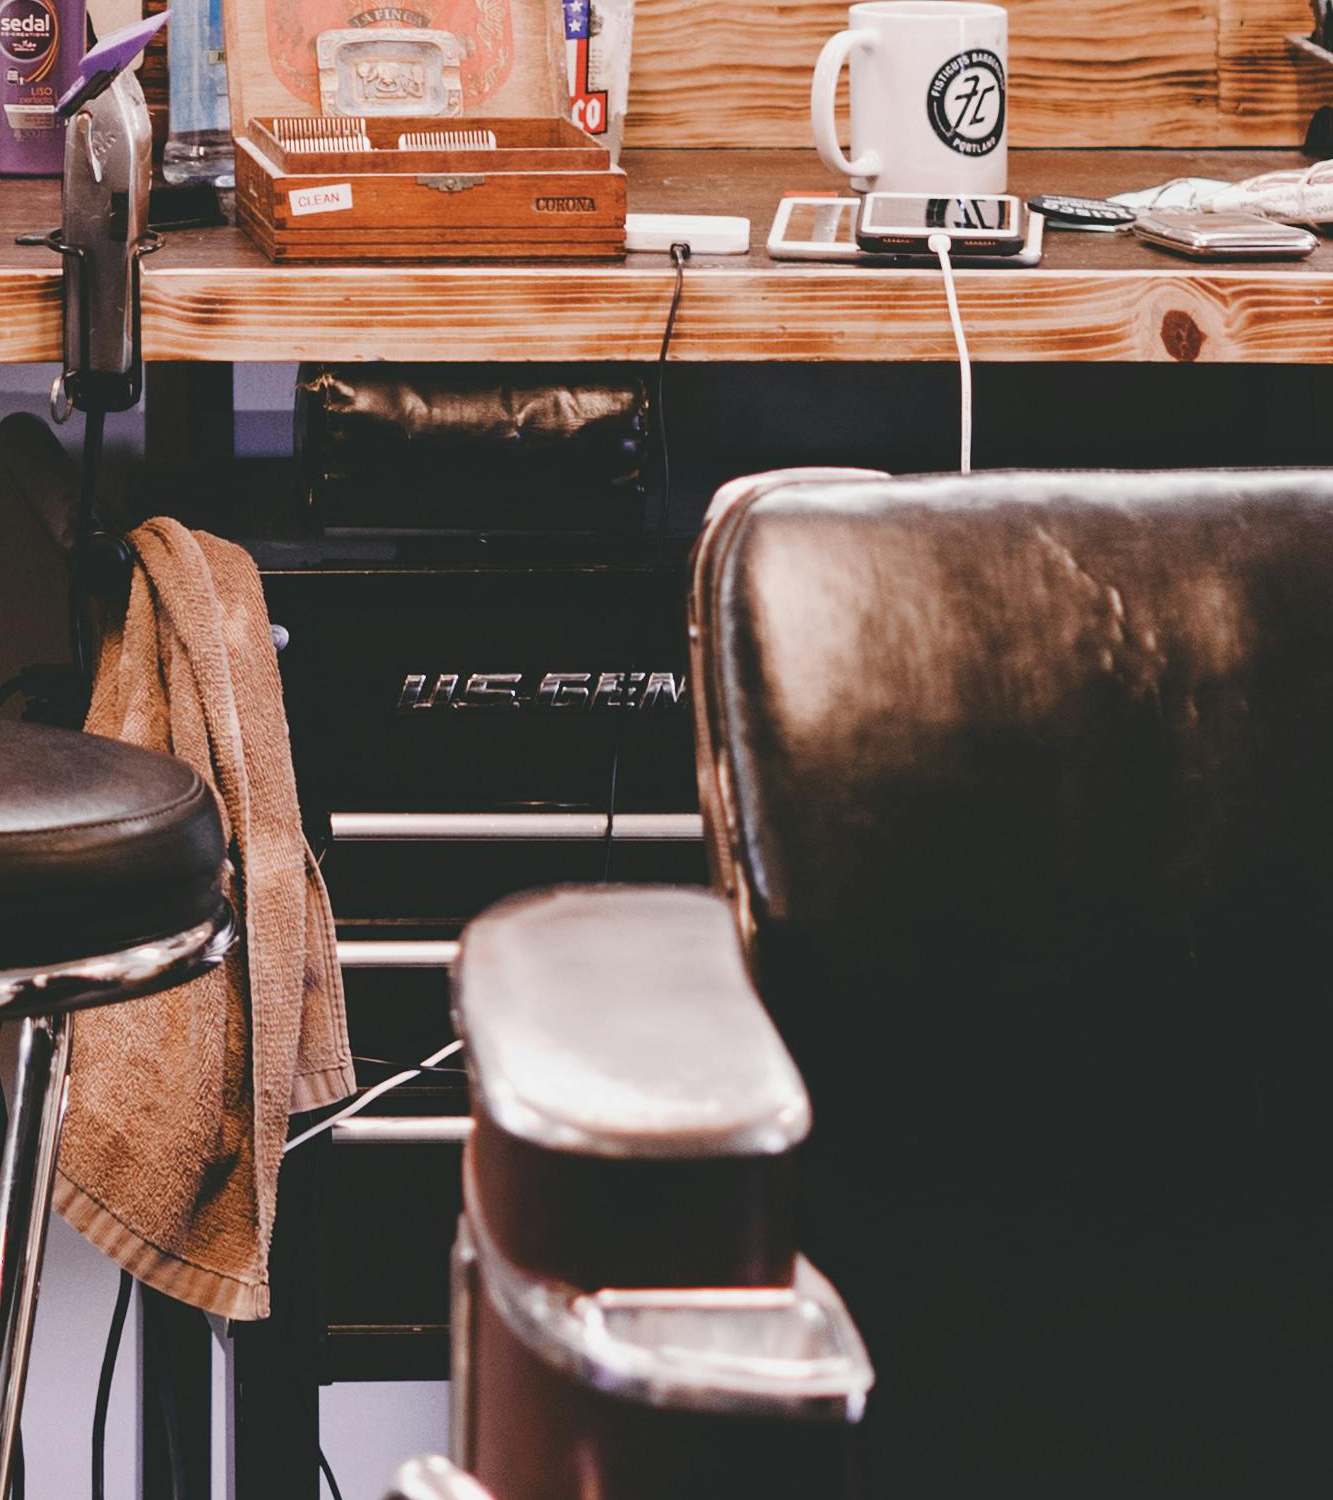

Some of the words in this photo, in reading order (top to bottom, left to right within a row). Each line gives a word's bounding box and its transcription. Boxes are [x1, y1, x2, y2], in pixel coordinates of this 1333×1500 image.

[0, 13, 50, 32] sedal
[30, 87, 53, 96] LISO
[297, 192, 340, 208] CLEAN
[536, 197, 597, 212] CORONA
